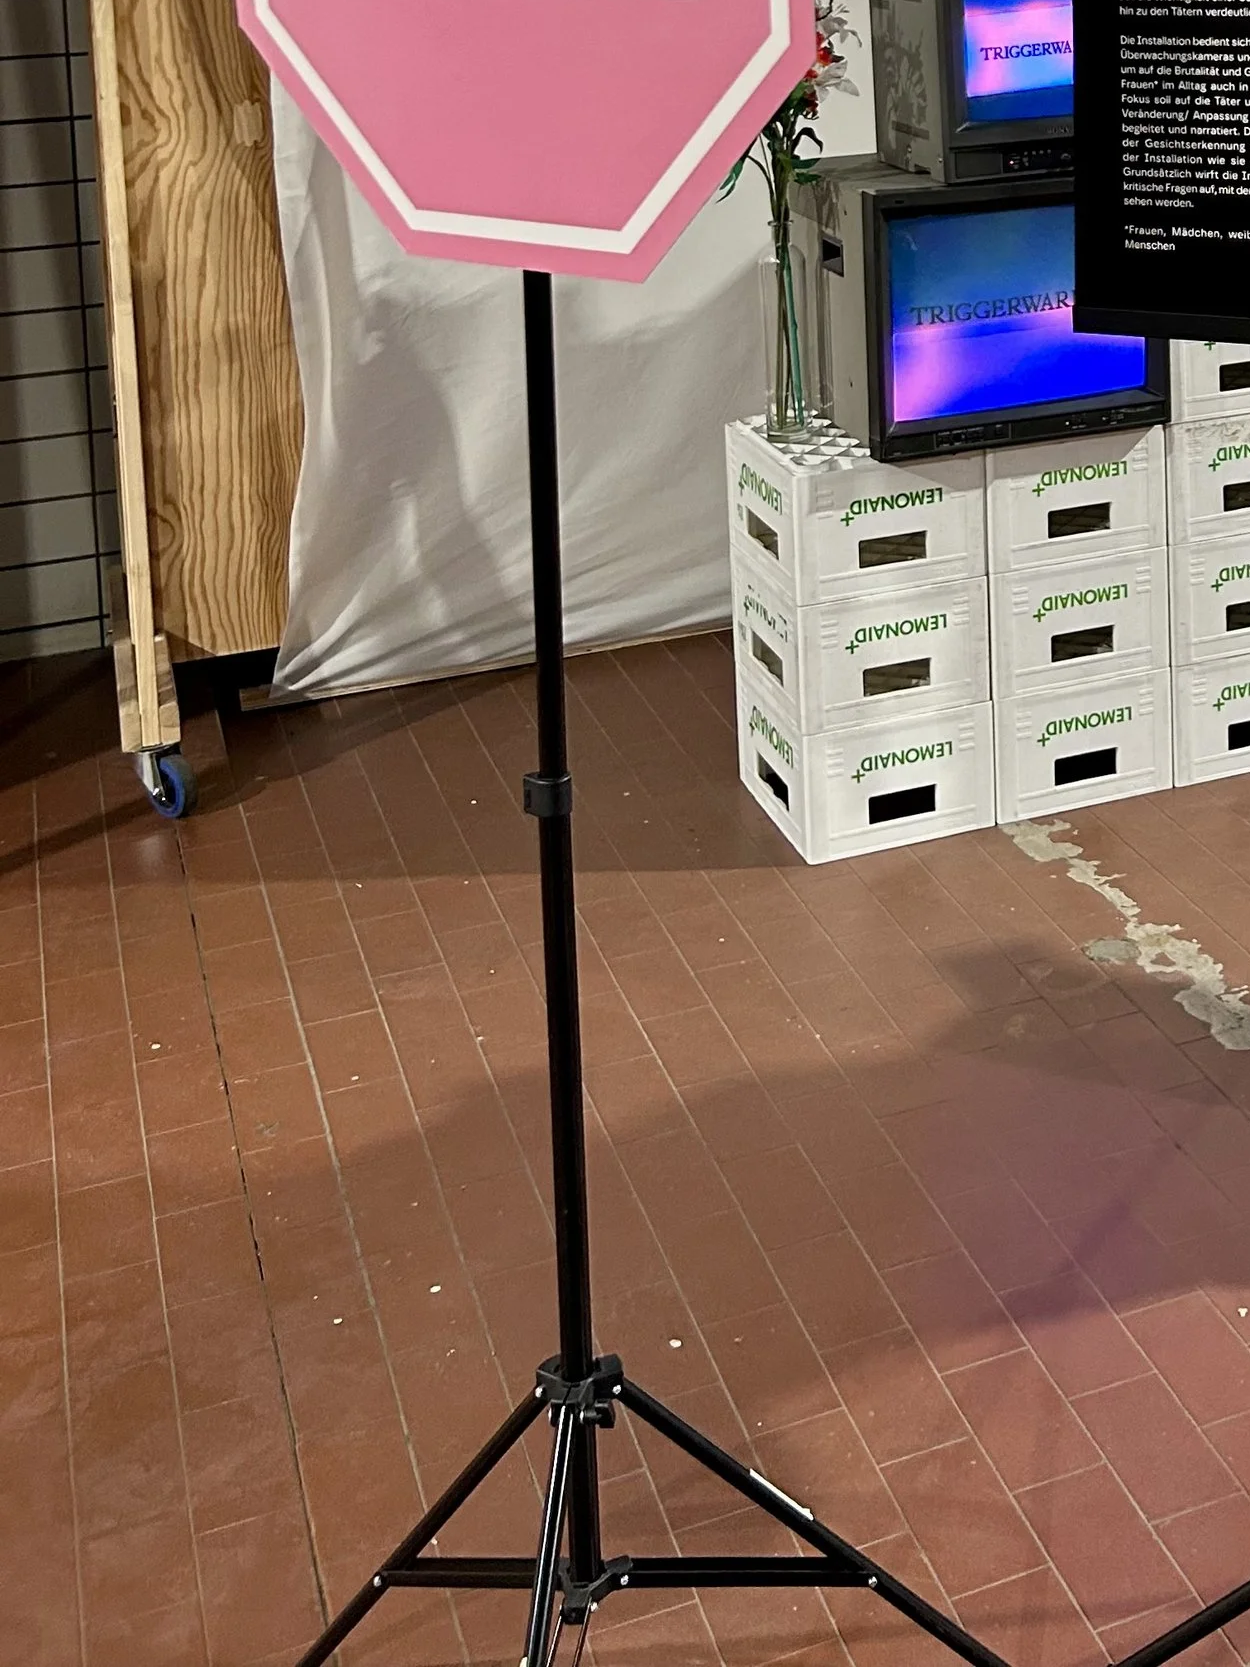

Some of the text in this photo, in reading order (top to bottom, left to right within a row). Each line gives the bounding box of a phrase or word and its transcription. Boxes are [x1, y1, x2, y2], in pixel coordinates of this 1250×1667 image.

[1171, 6, 1203, 16] Tätern
[1136, 35, 1191, 45] Installation
[1192, 37, 1230, 46] bedient
[980, 40, 1073, 61] TRIGGERWA
[1120, 48, 1235, 63] Überwachungskameras
[1174, 65, 1220, 76] Brutalität
[1177, 81, 1207, 93] Alltag
[1209, 81, 1236, 91] auch
[1121, 93, 1150, 103] Fokus
[1213, 96, 1241, 106] Täter
[1192, 110, 1249, 123] Anpassung
[1121, 123, 1165, 135] begleitet
[1190, 126, 1240, 136] narratiert.
[1144, 138, 1246, 153] Gesichtserkennung
[1144, 153, 1203, 164] Installation
[1122, 167, 1192, 178] Grundsätzlich
[1194, 169, 1219, 179] wirft
[1122, 181, 1164, 192] kritische
[1165, 182, 1198, 195] Fragen
[1198, 184, 1217, 195] auf,
[1123, 196, 1194, 208] sehen werden.
[1171, 227, 1223, 239] Mädchen,
[1124, 239, 1176, 250] Menschen
[909, 289, 1075, 325] TRIGGERWAR
